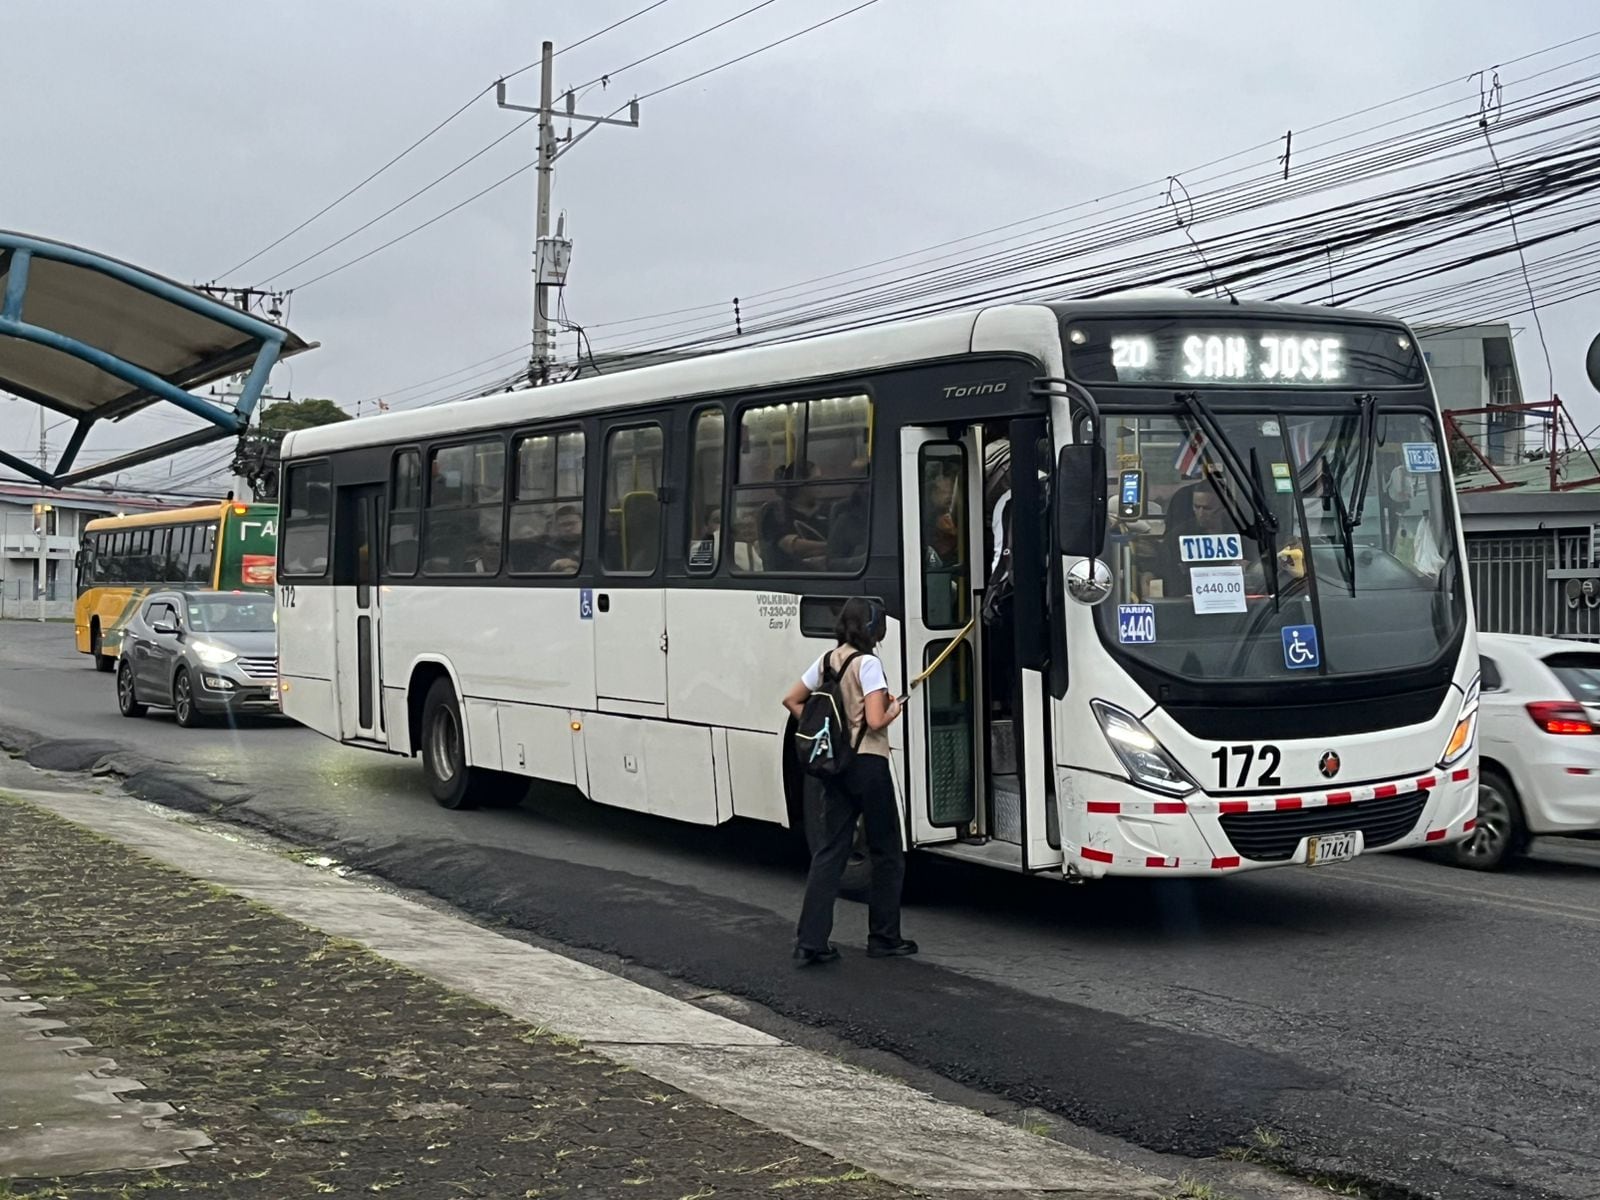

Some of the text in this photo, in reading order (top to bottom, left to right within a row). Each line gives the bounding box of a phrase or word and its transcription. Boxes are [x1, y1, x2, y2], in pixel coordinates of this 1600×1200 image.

[1183, 335, 1247, 378] SAN
[1259, 337, 1342, 379] JOSE
[943, 382, 1007, 399] Torino
[1183, 536, 1239, 559] TIBAS
[281, 585, 296, 608] 172
[1120, 606, 1152, 614] TARIFA
[1211, 744, 1281, 788] 172
[1320, 840, 1350, 859] 17424
